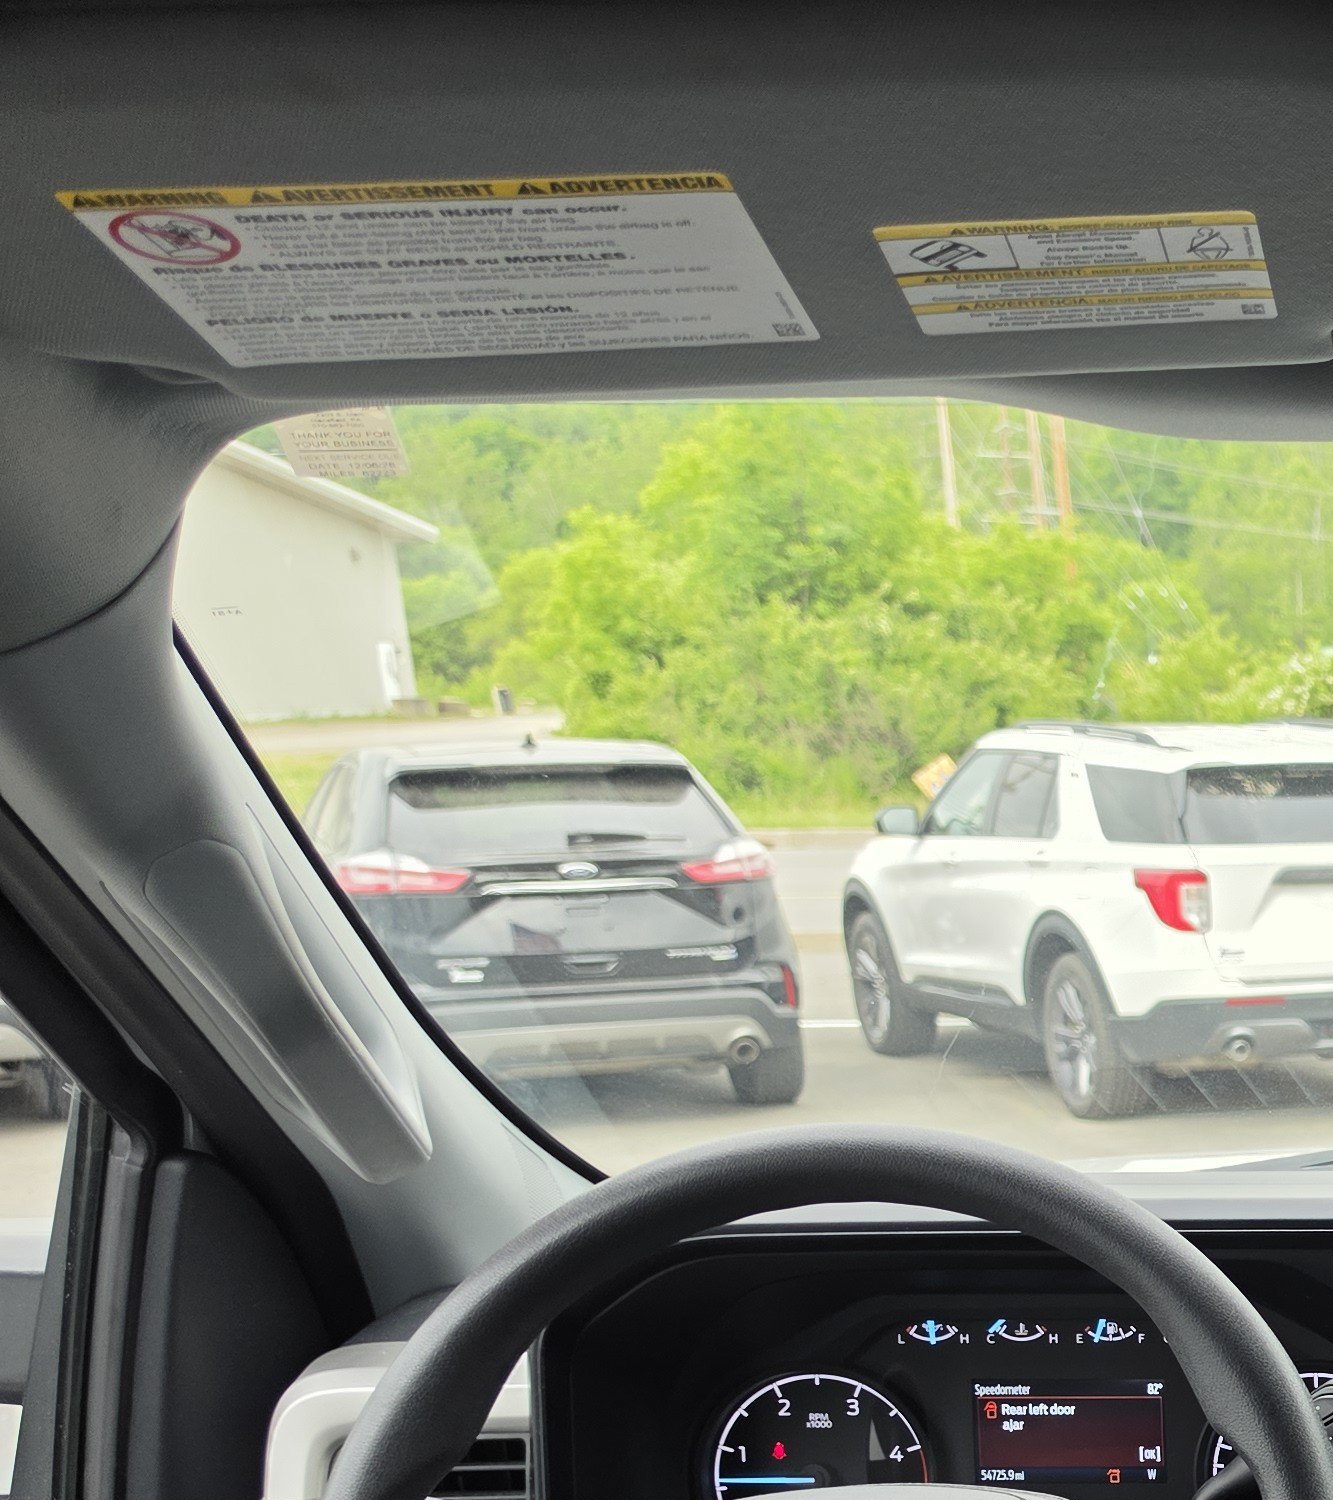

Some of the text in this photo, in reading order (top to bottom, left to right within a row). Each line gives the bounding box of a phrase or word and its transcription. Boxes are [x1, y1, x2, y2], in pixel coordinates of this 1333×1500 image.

[100, 176, 724, 206] WARNING AVERTISSEMENT ADVERTENCIA
[897, 1334, 905, 1345] L
[959, 1333, 970, 1345] H
[986, 1333, 996, 1345] C
[1048, 1333, 1058, 1345] H
[1076, 1333, 1084, 1345] E
[1137, 1333, 1145, 1345] F
[974, 1384, 1031, 1397] Speedometer
[1146, 1382, 1164, 1395] 82°
[777, 1399, 792, 1416] 2
[846, 1398, 861, 1417] 3
[1001, 1403, 1076, 1415] Rear left door
[808, 1413, 829, 1421] RPM
[805, 1420, 833, 1429] x1000
[1002, 1419, 1025, 1432] ajar
[738, 1445, 747, 1463] 1
[889, 1444, 904, 1462] 4
[980, 1469, 1014, 1481] 54725.9
[1146, 1469, 1157, 1480] W
